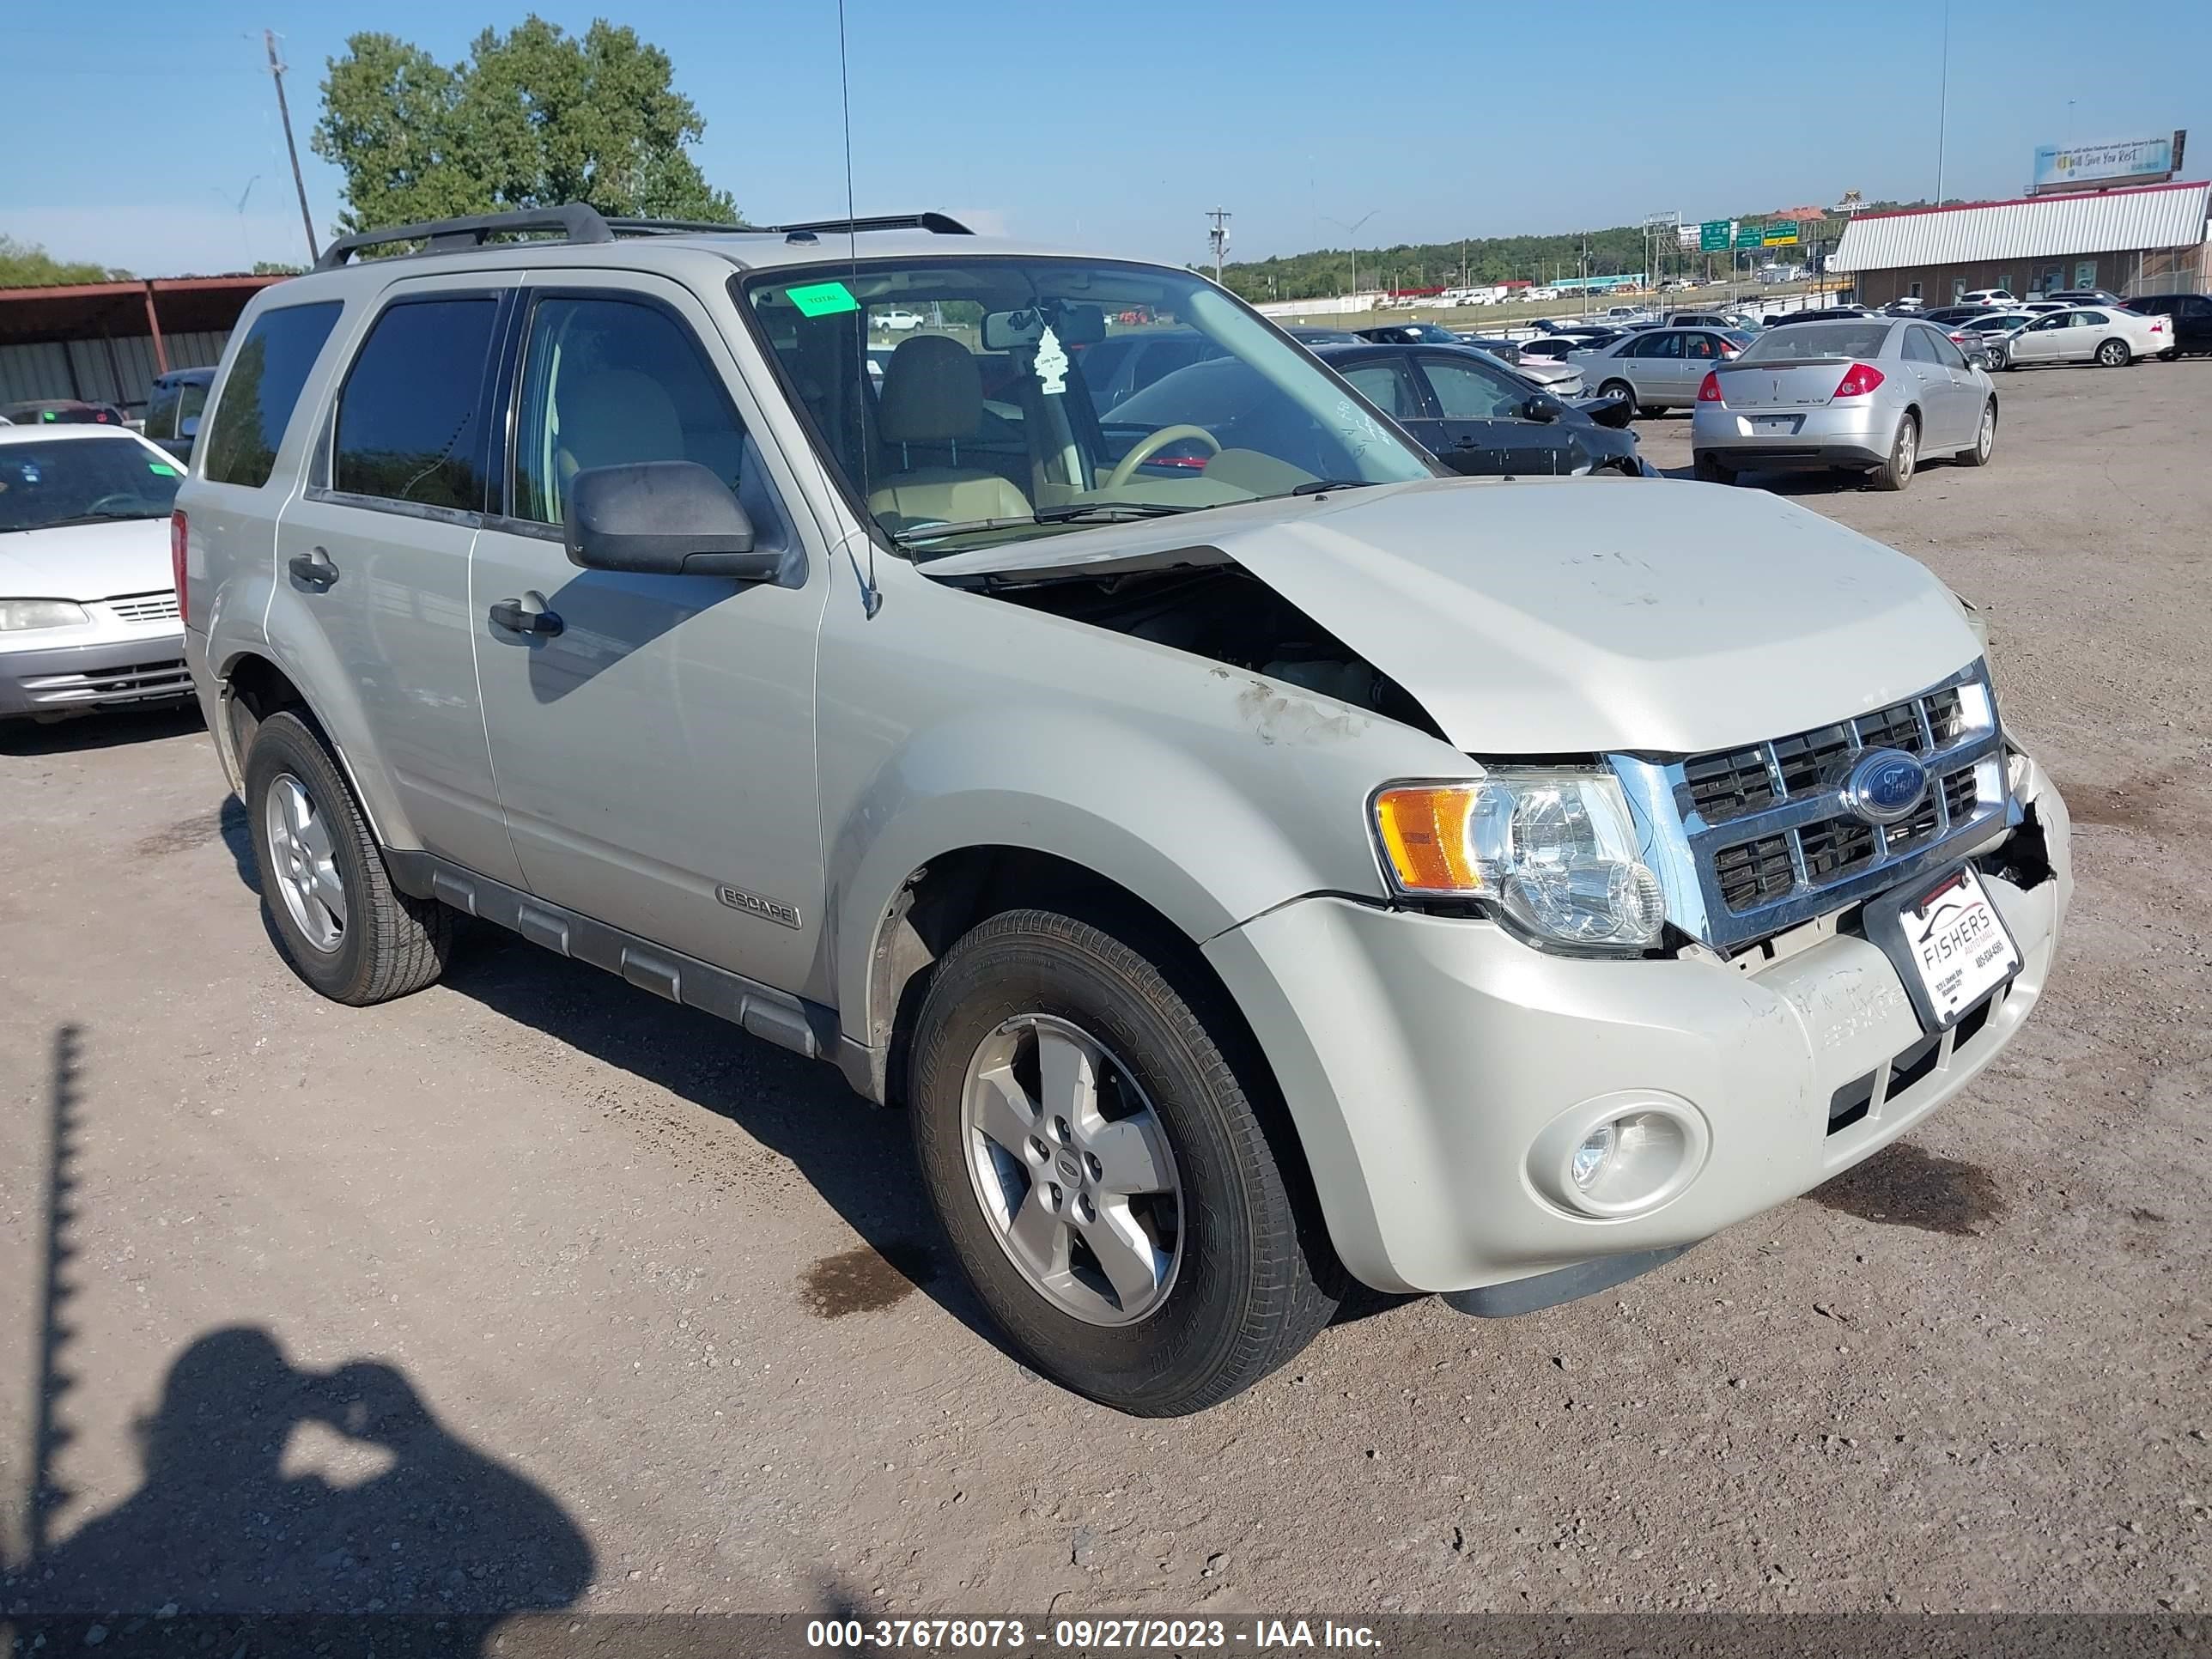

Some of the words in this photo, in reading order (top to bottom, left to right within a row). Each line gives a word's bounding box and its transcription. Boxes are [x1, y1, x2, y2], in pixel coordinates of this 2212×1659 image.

[808, 295, 839, 303] TOTAL
[724, 886, 795, 925] ESCAPE
[1923, 907, 1990, 970] FISHERS
